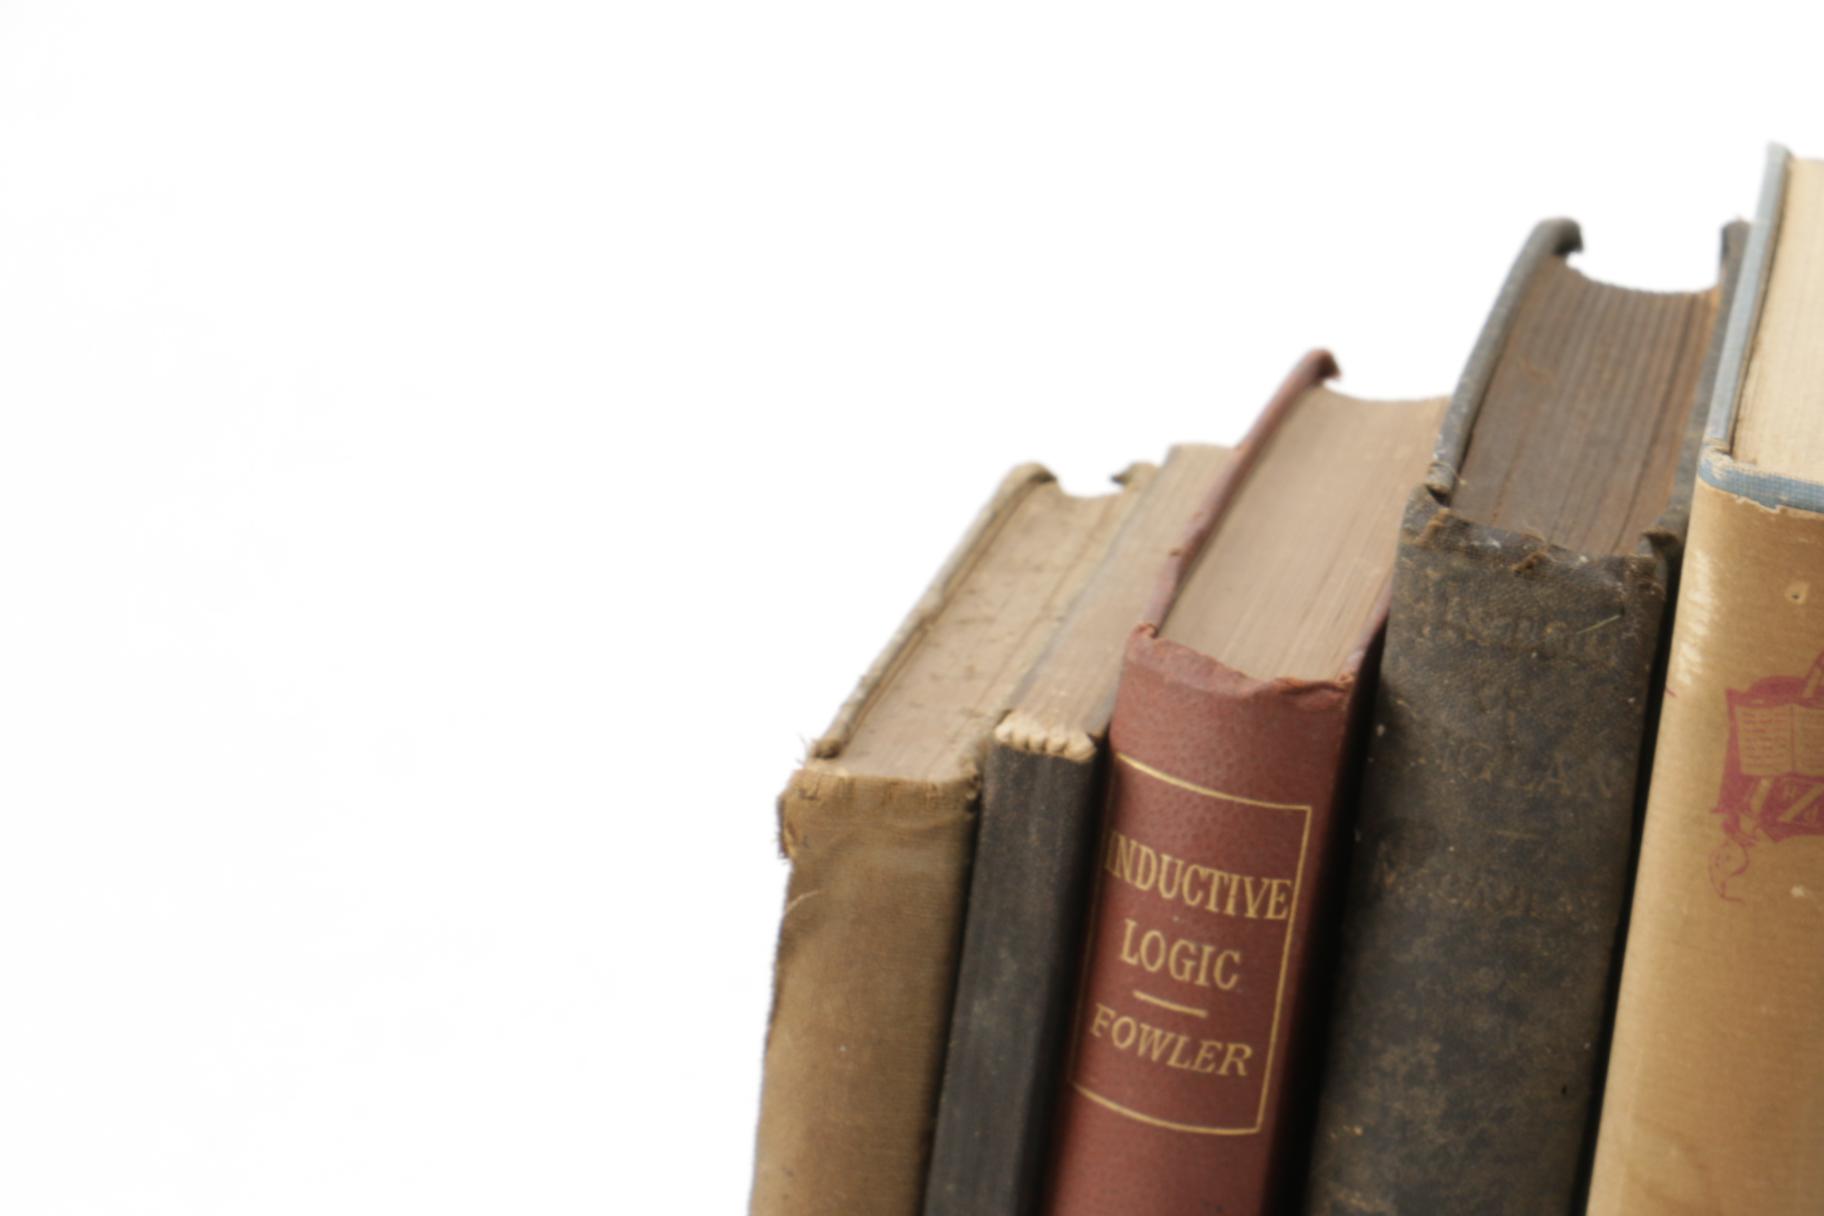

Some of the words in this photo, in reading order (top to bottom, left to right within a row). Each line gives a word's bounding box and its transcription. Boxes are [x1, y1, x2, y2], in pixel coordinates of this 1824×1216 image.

[1104, 830, 1292, 921] INDUCTIVE
[1120, 918, 1241, 991] LOGIC
[1090, 1003, 1254, 1077] FOWLER
